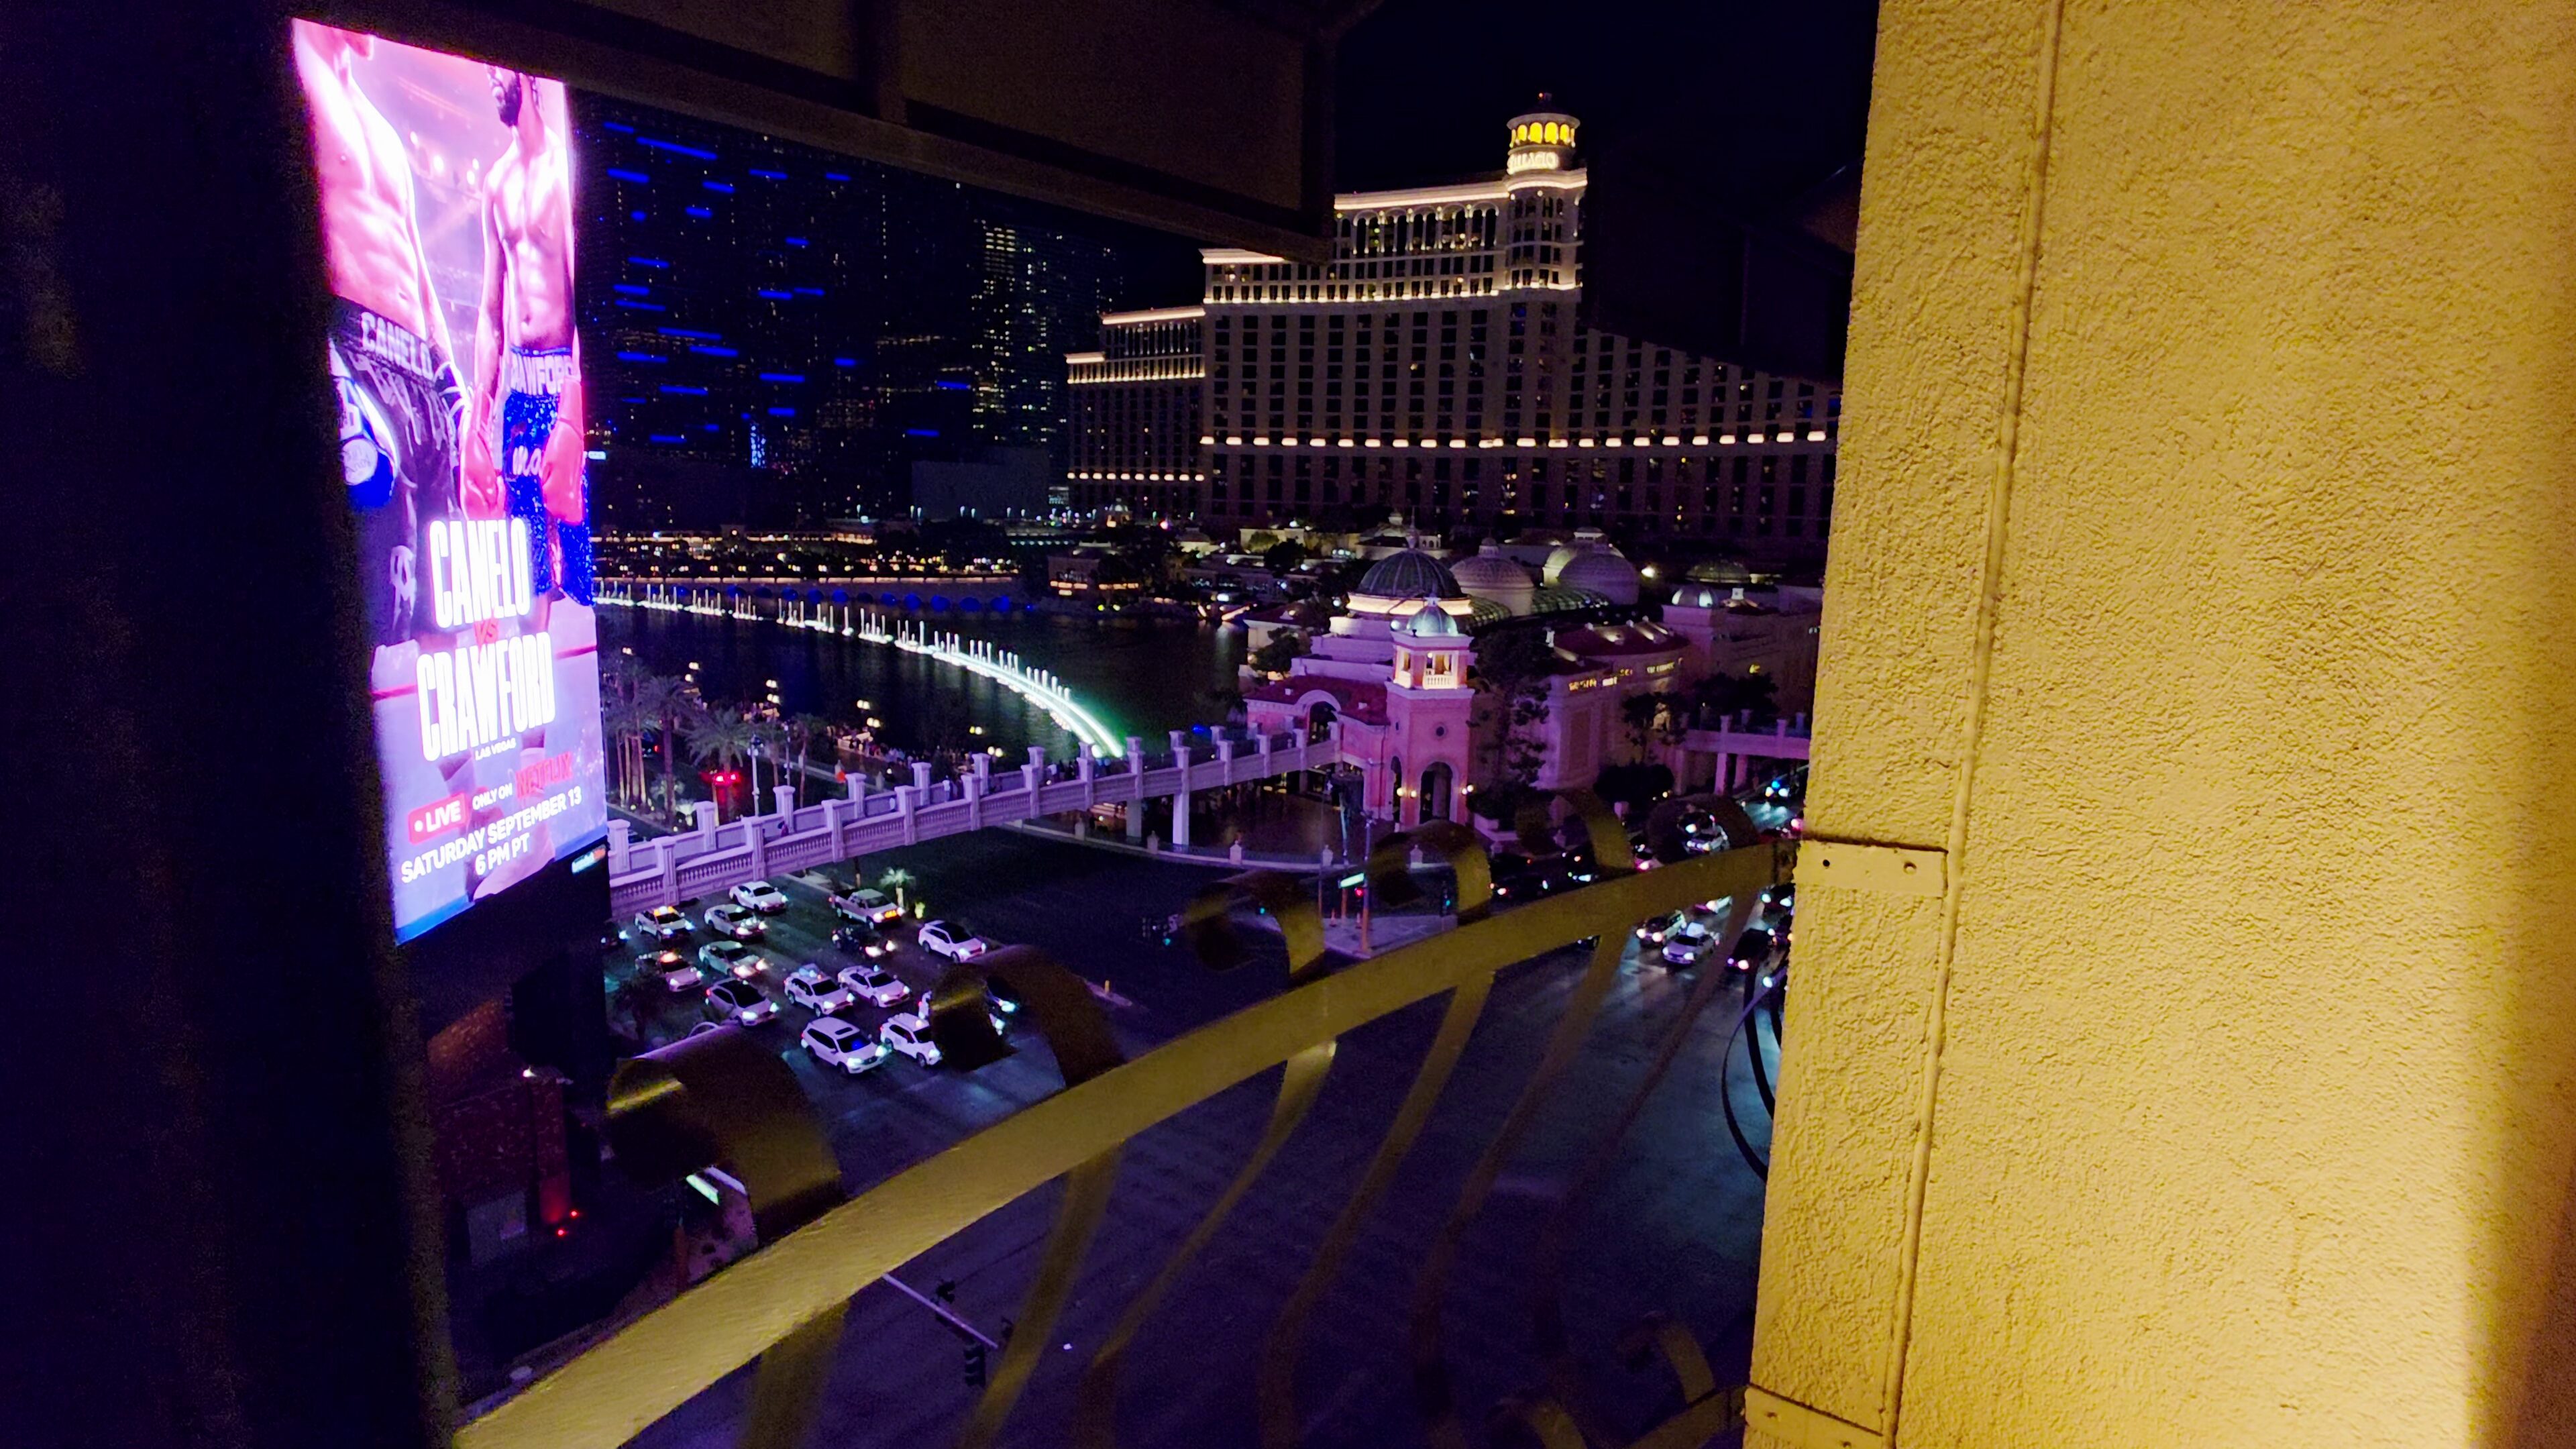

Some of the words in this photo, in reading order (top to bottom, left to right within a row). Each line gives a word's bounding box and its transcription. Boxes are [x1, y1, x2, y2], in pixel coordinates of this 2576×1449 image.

[1507, 152, 1560, 174] LLAGIO
[361, 312, 434, 380] CANELO
[429, 517, 531, 629] CANELO
[473, 619, 499, 649] VS
[417, 631, 556, 762] CRAWFORD
[475, 746, 491, 761] LAS
[491, 738, 517, 755] VEGAS
[425, 800, 462, 832] LIVE
[472, 790, 498, 810] ONLY
[498, 783, 513, 800] ON
[515, 751, 574, 800] NETFLIX
[400, 827, 486, 883] SATURDAY
[487, 793, 568, 844] SEPTEMBER
[568, 786, 582, 807] 13
[475, 854, 486, 875] 6
[488, 841, 511, 870] PM
[511, 833, 530, 858] PT
